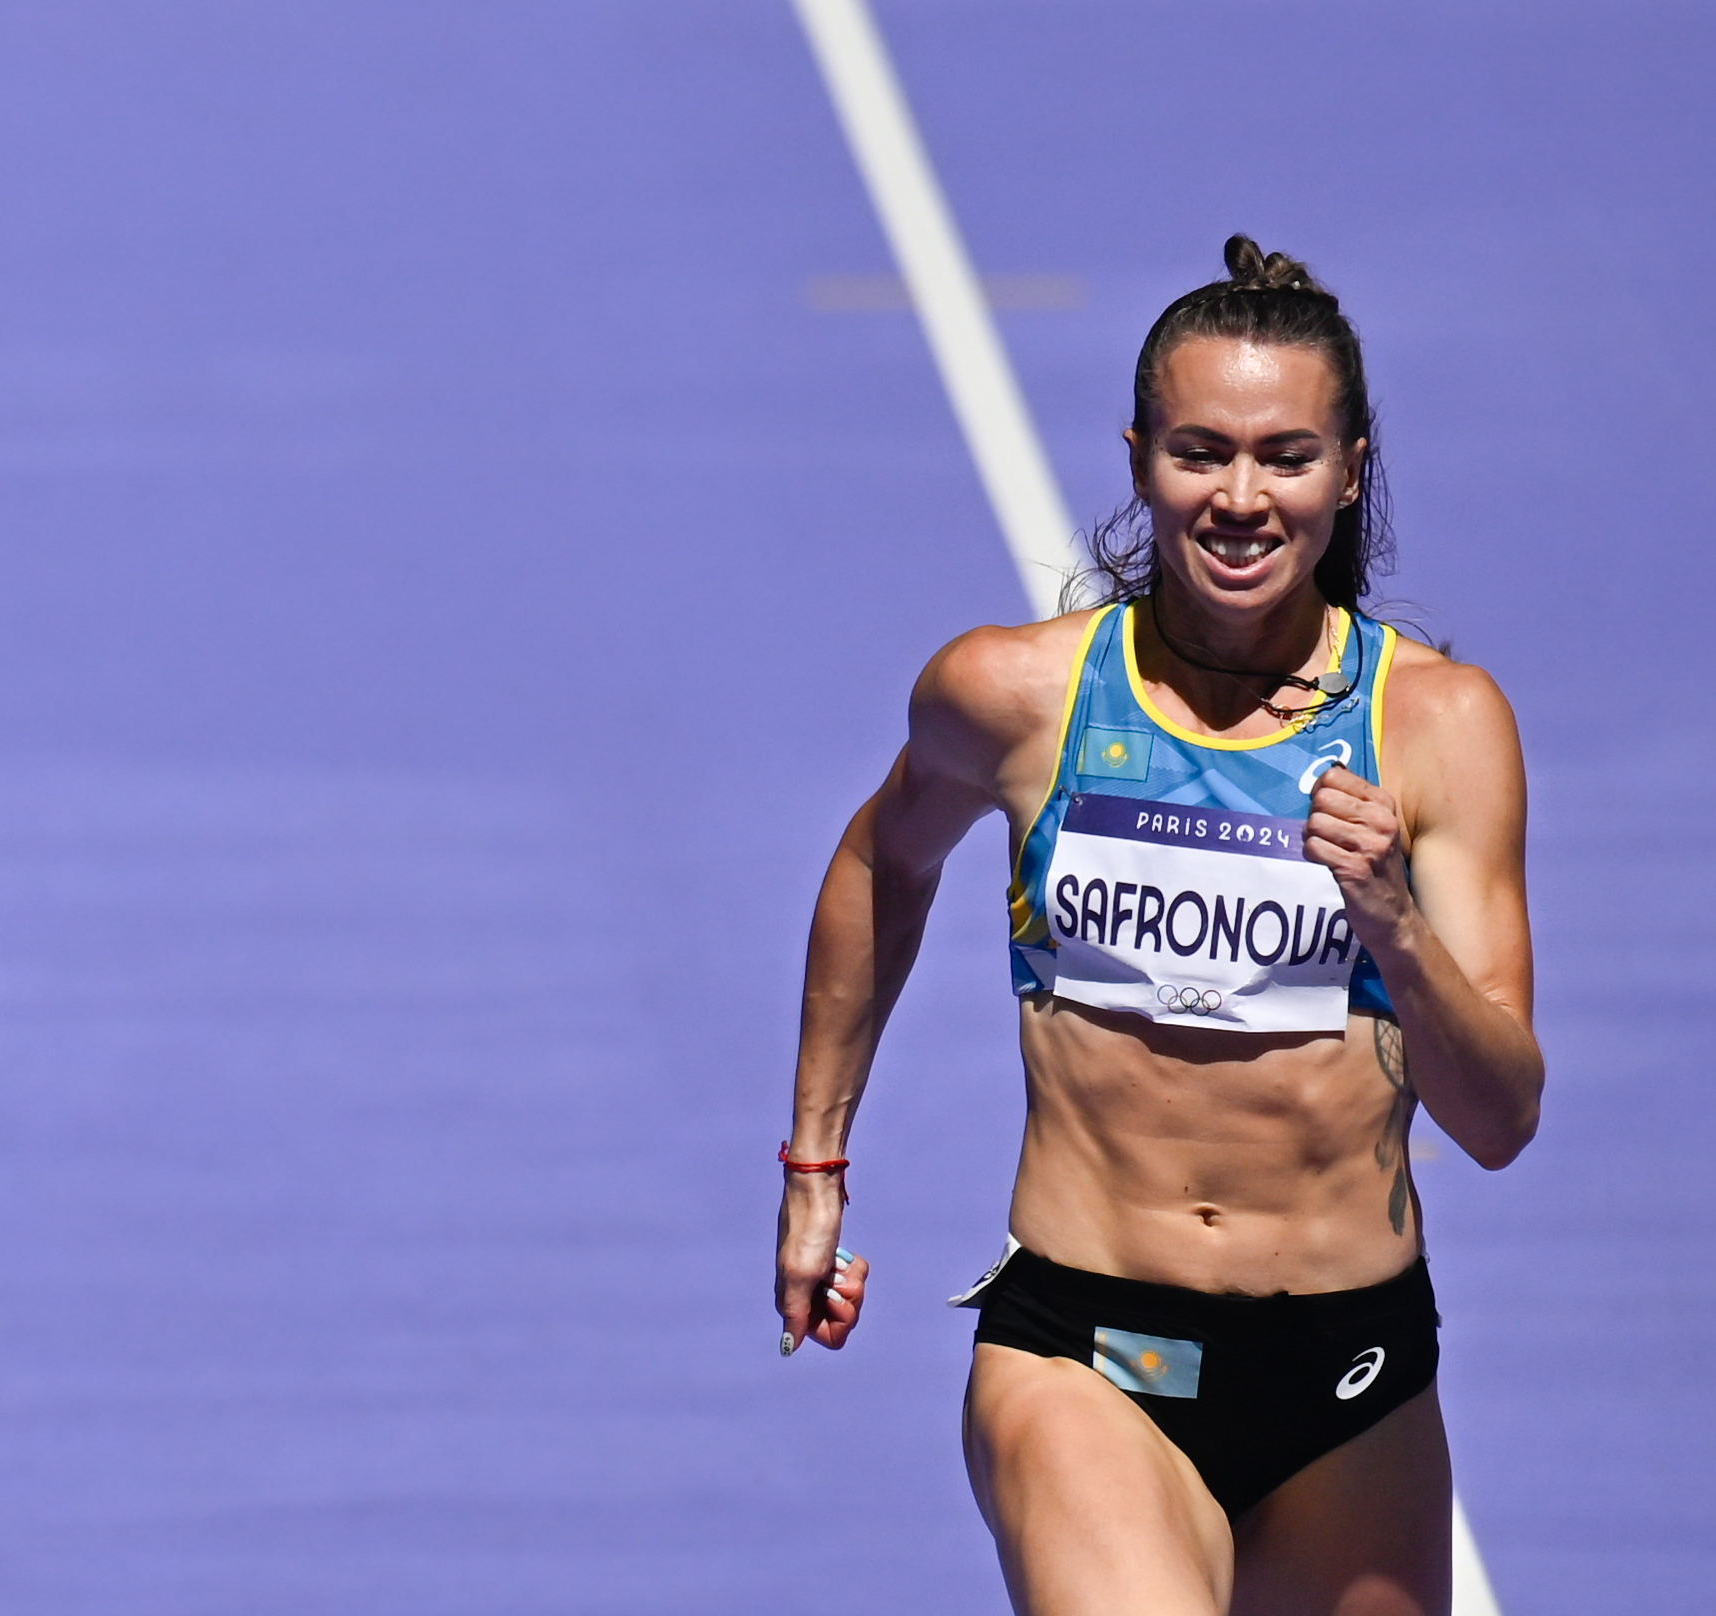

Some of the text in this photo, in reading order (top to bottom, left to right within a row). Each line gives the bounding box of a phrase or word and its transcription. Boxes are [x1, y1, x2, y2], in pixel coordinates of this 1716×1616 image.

[1136, 811, 1290, 849] PARIS 2024
[1055, 874, 1354, 967] SAFRONOVA
